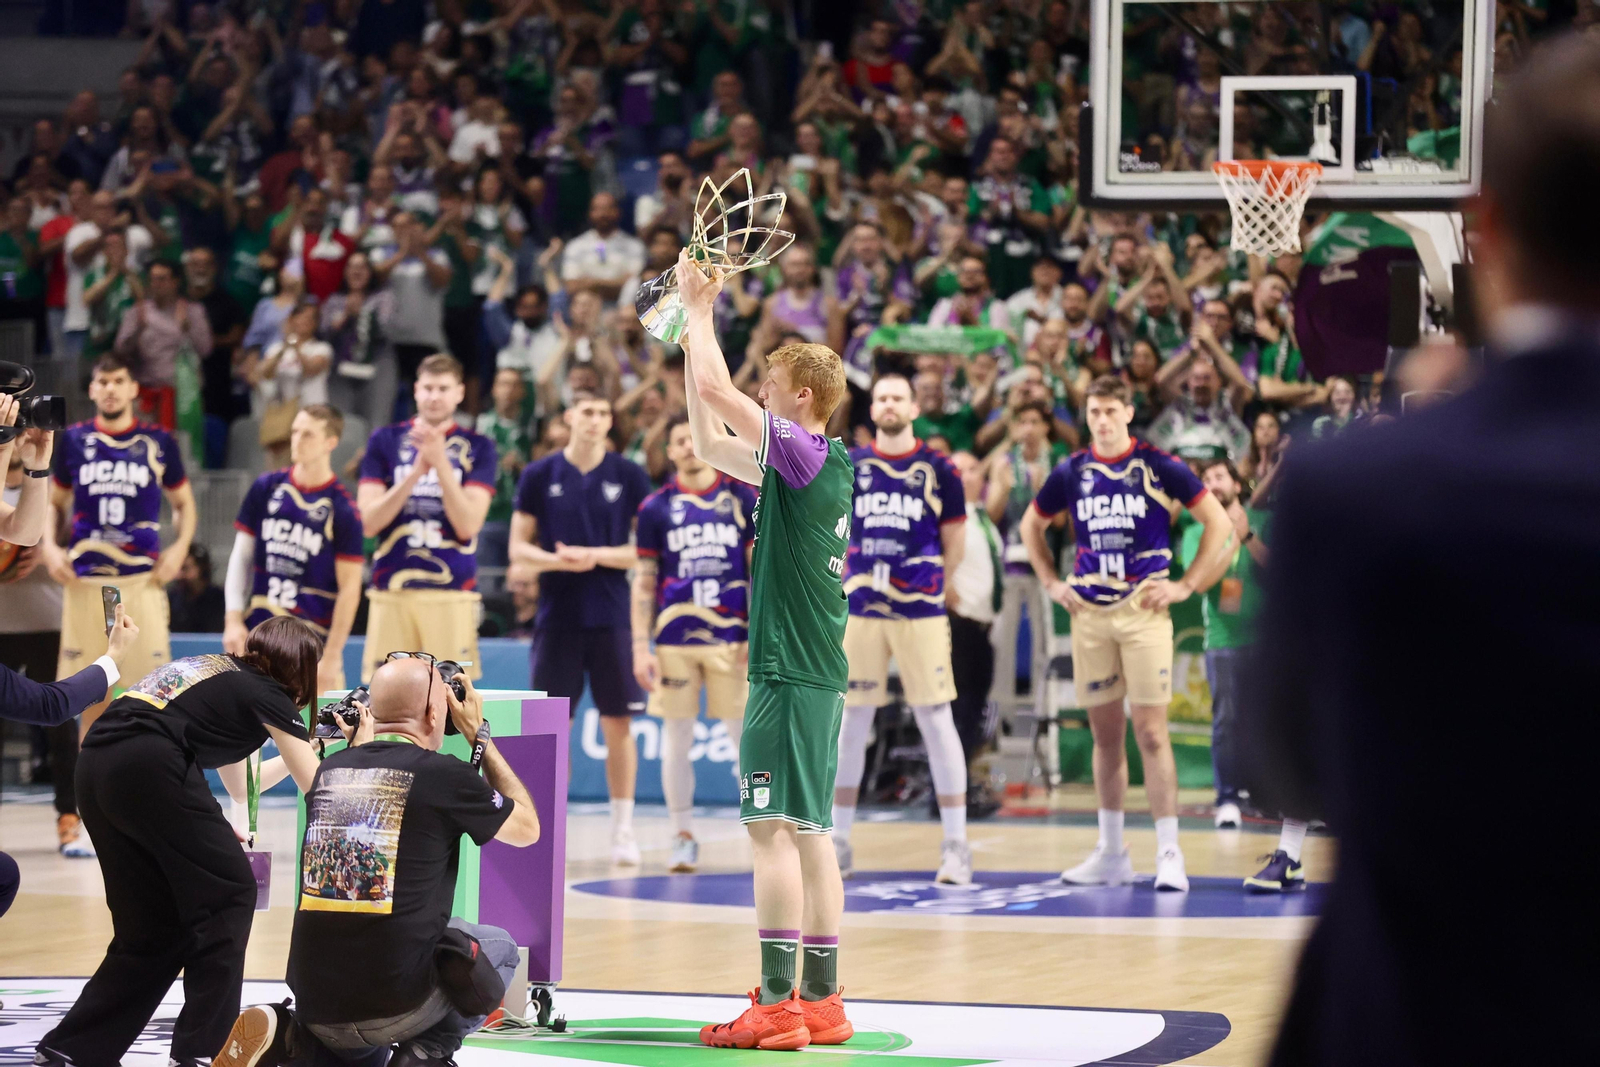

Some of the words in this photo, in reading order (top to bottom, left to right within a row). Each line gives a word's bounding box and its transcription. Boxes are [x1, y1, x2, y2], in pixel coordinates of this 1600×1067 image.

[79, 460, 150, 488] UCAM
[98, 496, 126, 526] 19
[855, 491, 924, 522] UCAM
[1076, 493, 1147, 522] UCAM
[261, 518, 324, 557] UCAM
[666, 522, 739, 552] UCAM
[1099, 552, 1126, 582] 14
[267, 576, 299, 609] 22
[692, 578, 722, 608] 12
